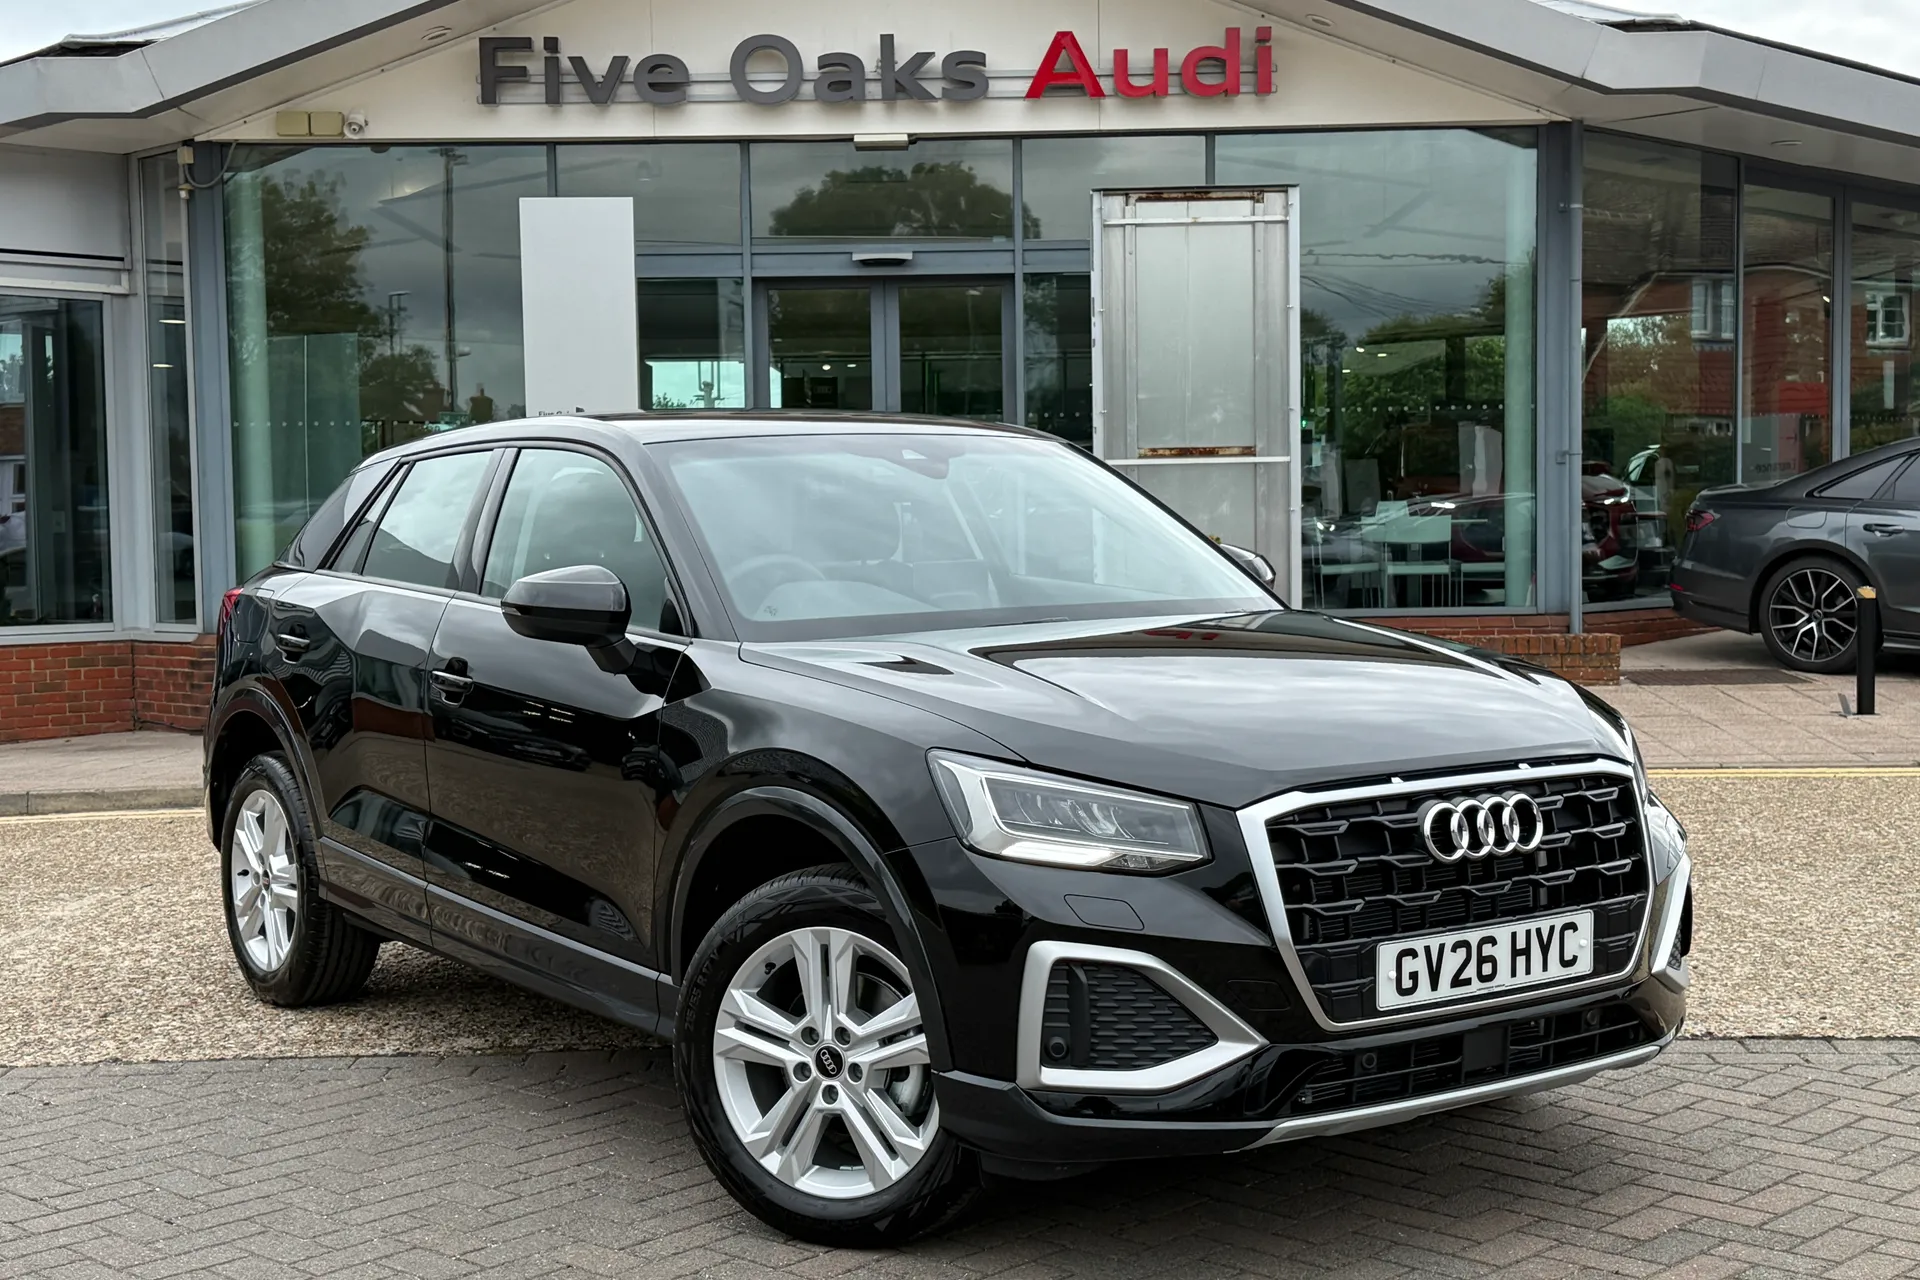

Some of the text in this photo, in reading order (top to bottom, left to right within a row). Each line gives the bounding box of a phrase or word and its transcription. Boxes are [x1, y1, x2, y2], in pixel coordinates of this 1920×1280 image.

[479, 26, 1273, 106] Five Oaks Audi
[1395, 921, 1579, 997] GV26 HYC
